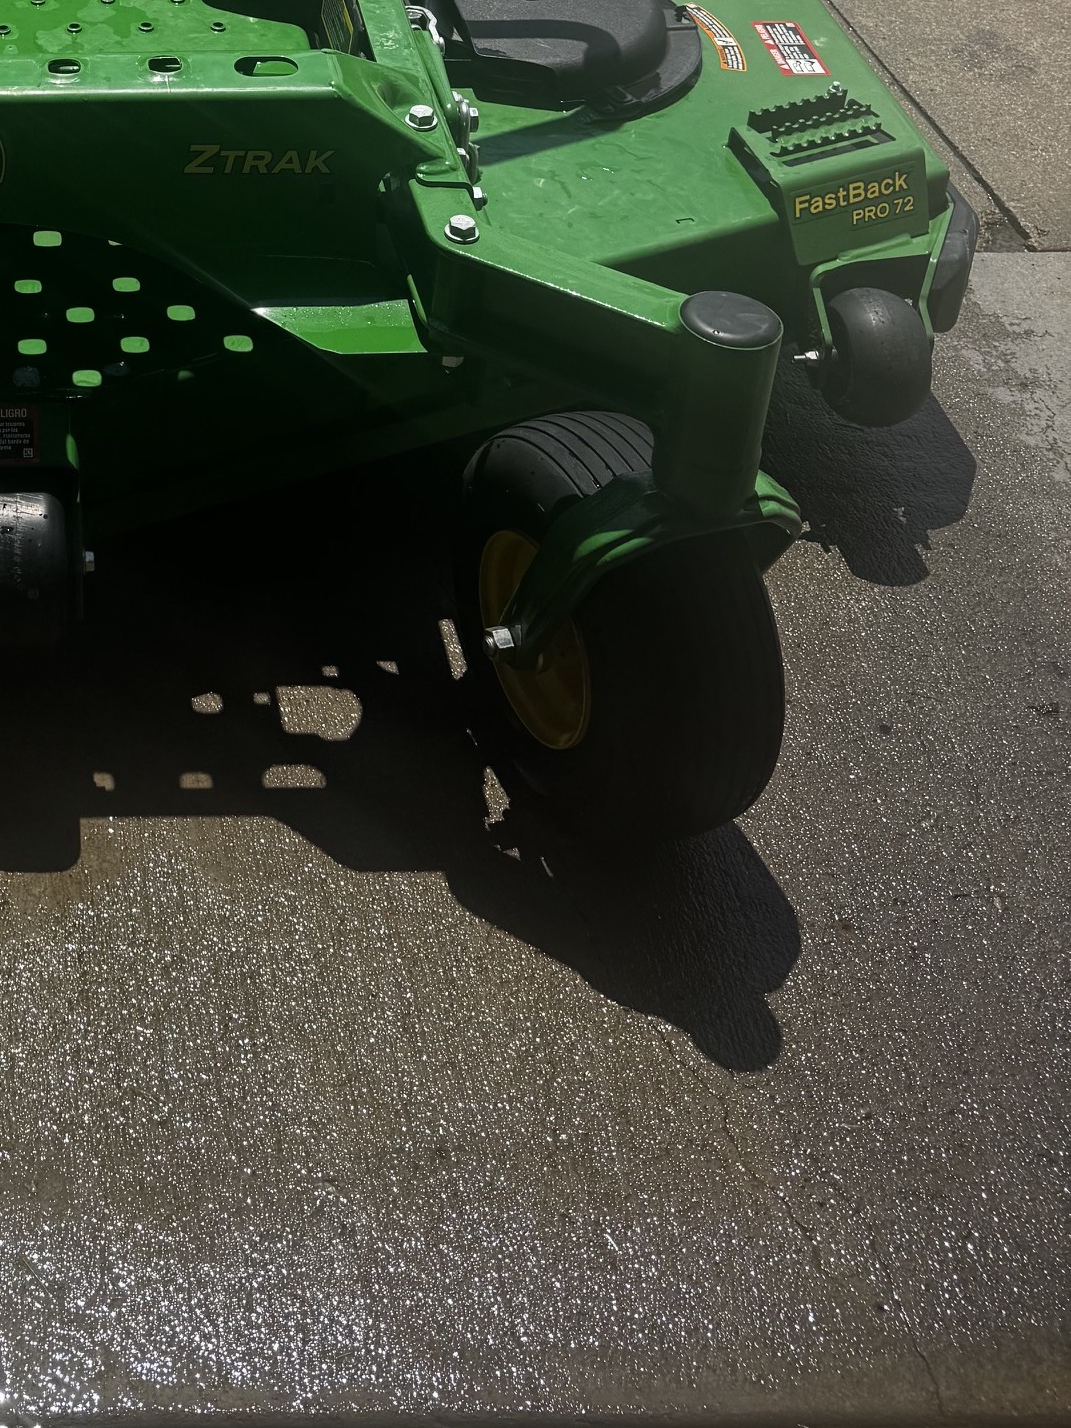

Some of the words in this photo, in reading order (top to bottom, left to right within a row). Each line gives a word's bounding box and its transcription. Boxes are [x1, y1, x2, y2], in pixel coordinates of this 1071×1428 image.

[183, 144, 336, 176] ZTRAK
[794, 171, 908, 218] FastBack
[852, 201, 890, 226] PRO
[893, 196, 914, 214] 72
